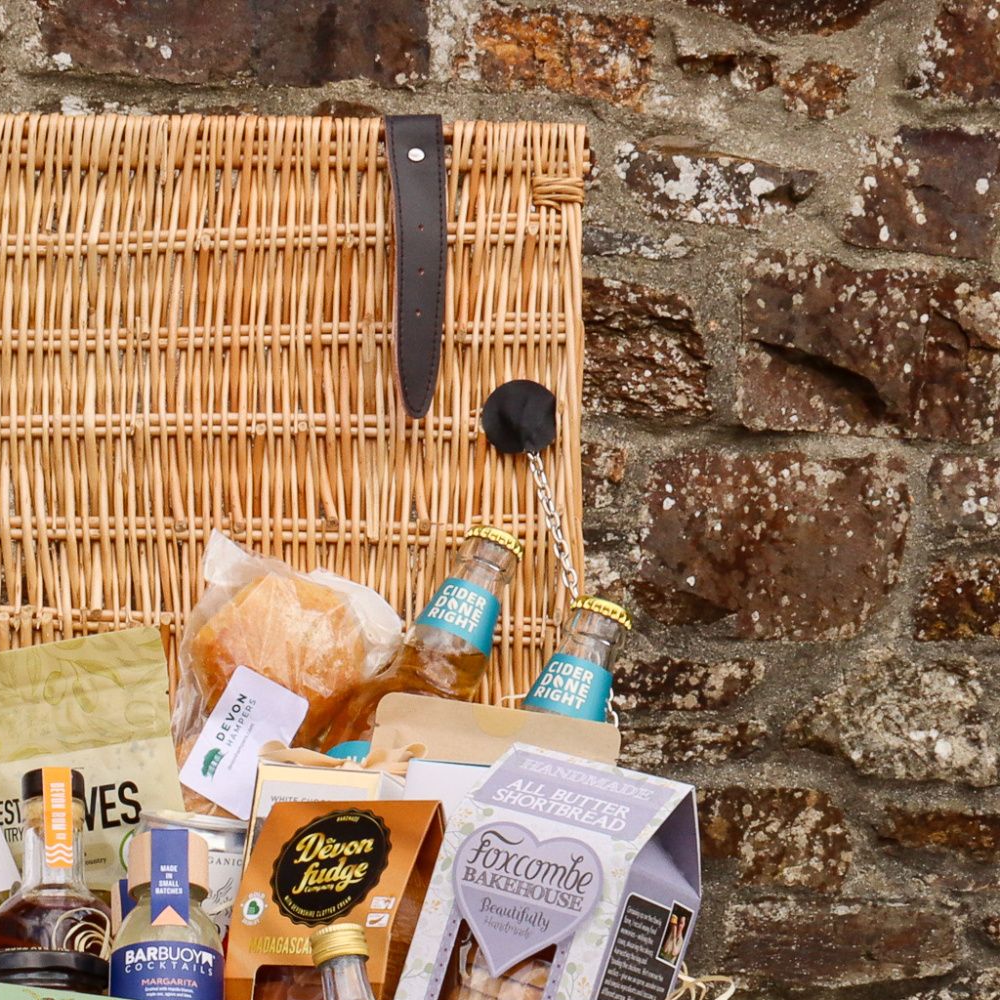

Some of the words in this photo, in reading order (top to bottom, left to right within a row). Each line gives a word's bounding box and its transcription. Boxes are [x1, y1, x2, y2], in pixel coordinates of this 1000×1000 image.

[443, 584, 487, 608] CIDER
[427, 606, 478, 633] RIGHT
[548, 661, 594, 682] CIDER
[534, 685, 587, 710] RIGHT
[216, 693, 248, 741] DEVON
[227, 699, 257, 747] HAMPERS
[520, 758, 654, 801] HANDMADE
[492, 788, 626, 832] SHORTBREAD
[506, 778, 545, 797] ALL
[551, 788, 631, 819] BUTTER
[293, 832, 374, 864] Devon
[160, 864, 178, 873] MADE
[208, 856, 243, 867] GANIC
[158, 879, 180, 887] SMALL
[292, 857, 369, 895] fudge
[462, 865, 584, 912] BAKEHOUSE
[480, 896, 550, 932] Beautifully
[125, 946, 202, 965] BARBUOY
[249, 936, 312, 954] MADAGASCA
[125, 961, 213, 977] COCKTAILS
[141, 977, 198, 988] MARGARITA
